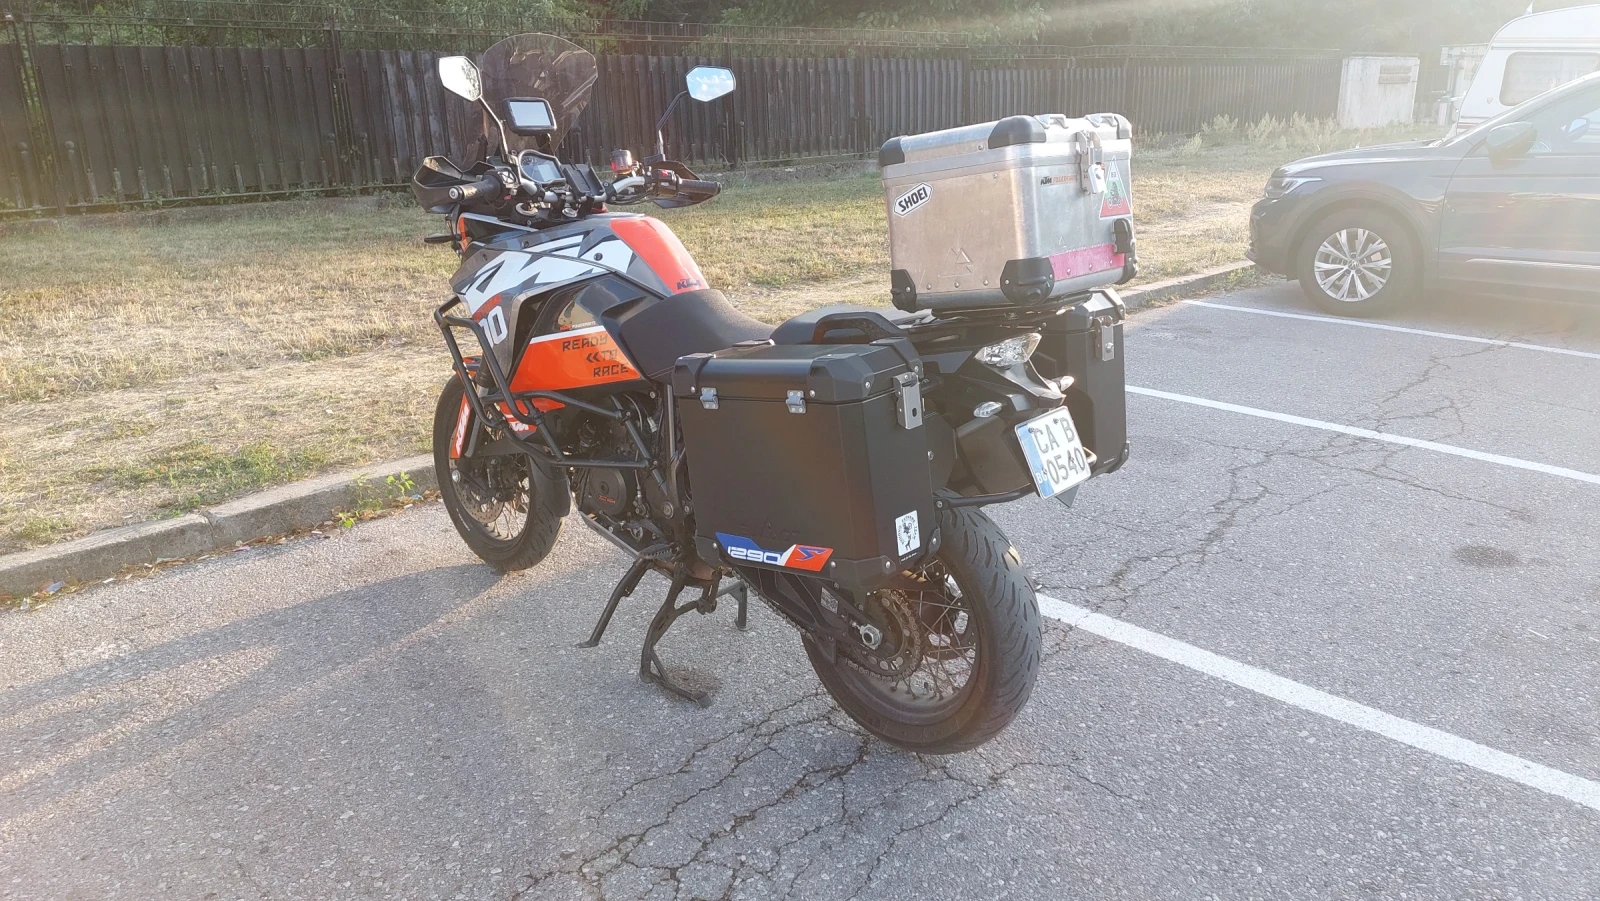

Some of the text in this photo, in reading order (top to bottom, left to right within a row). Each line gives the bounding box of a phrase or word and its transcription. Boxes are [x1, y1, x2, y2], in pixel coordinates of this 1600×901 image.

[898, 186, 928, 212] SHOEI
[562, 334, 608, 352] READY
[593, 362, 629, 378] RACE
[1033, 417, 1075, 454] CA B
[1047, 447, 1086, 484] 0540
[728, 545, 781, 565] 1290
